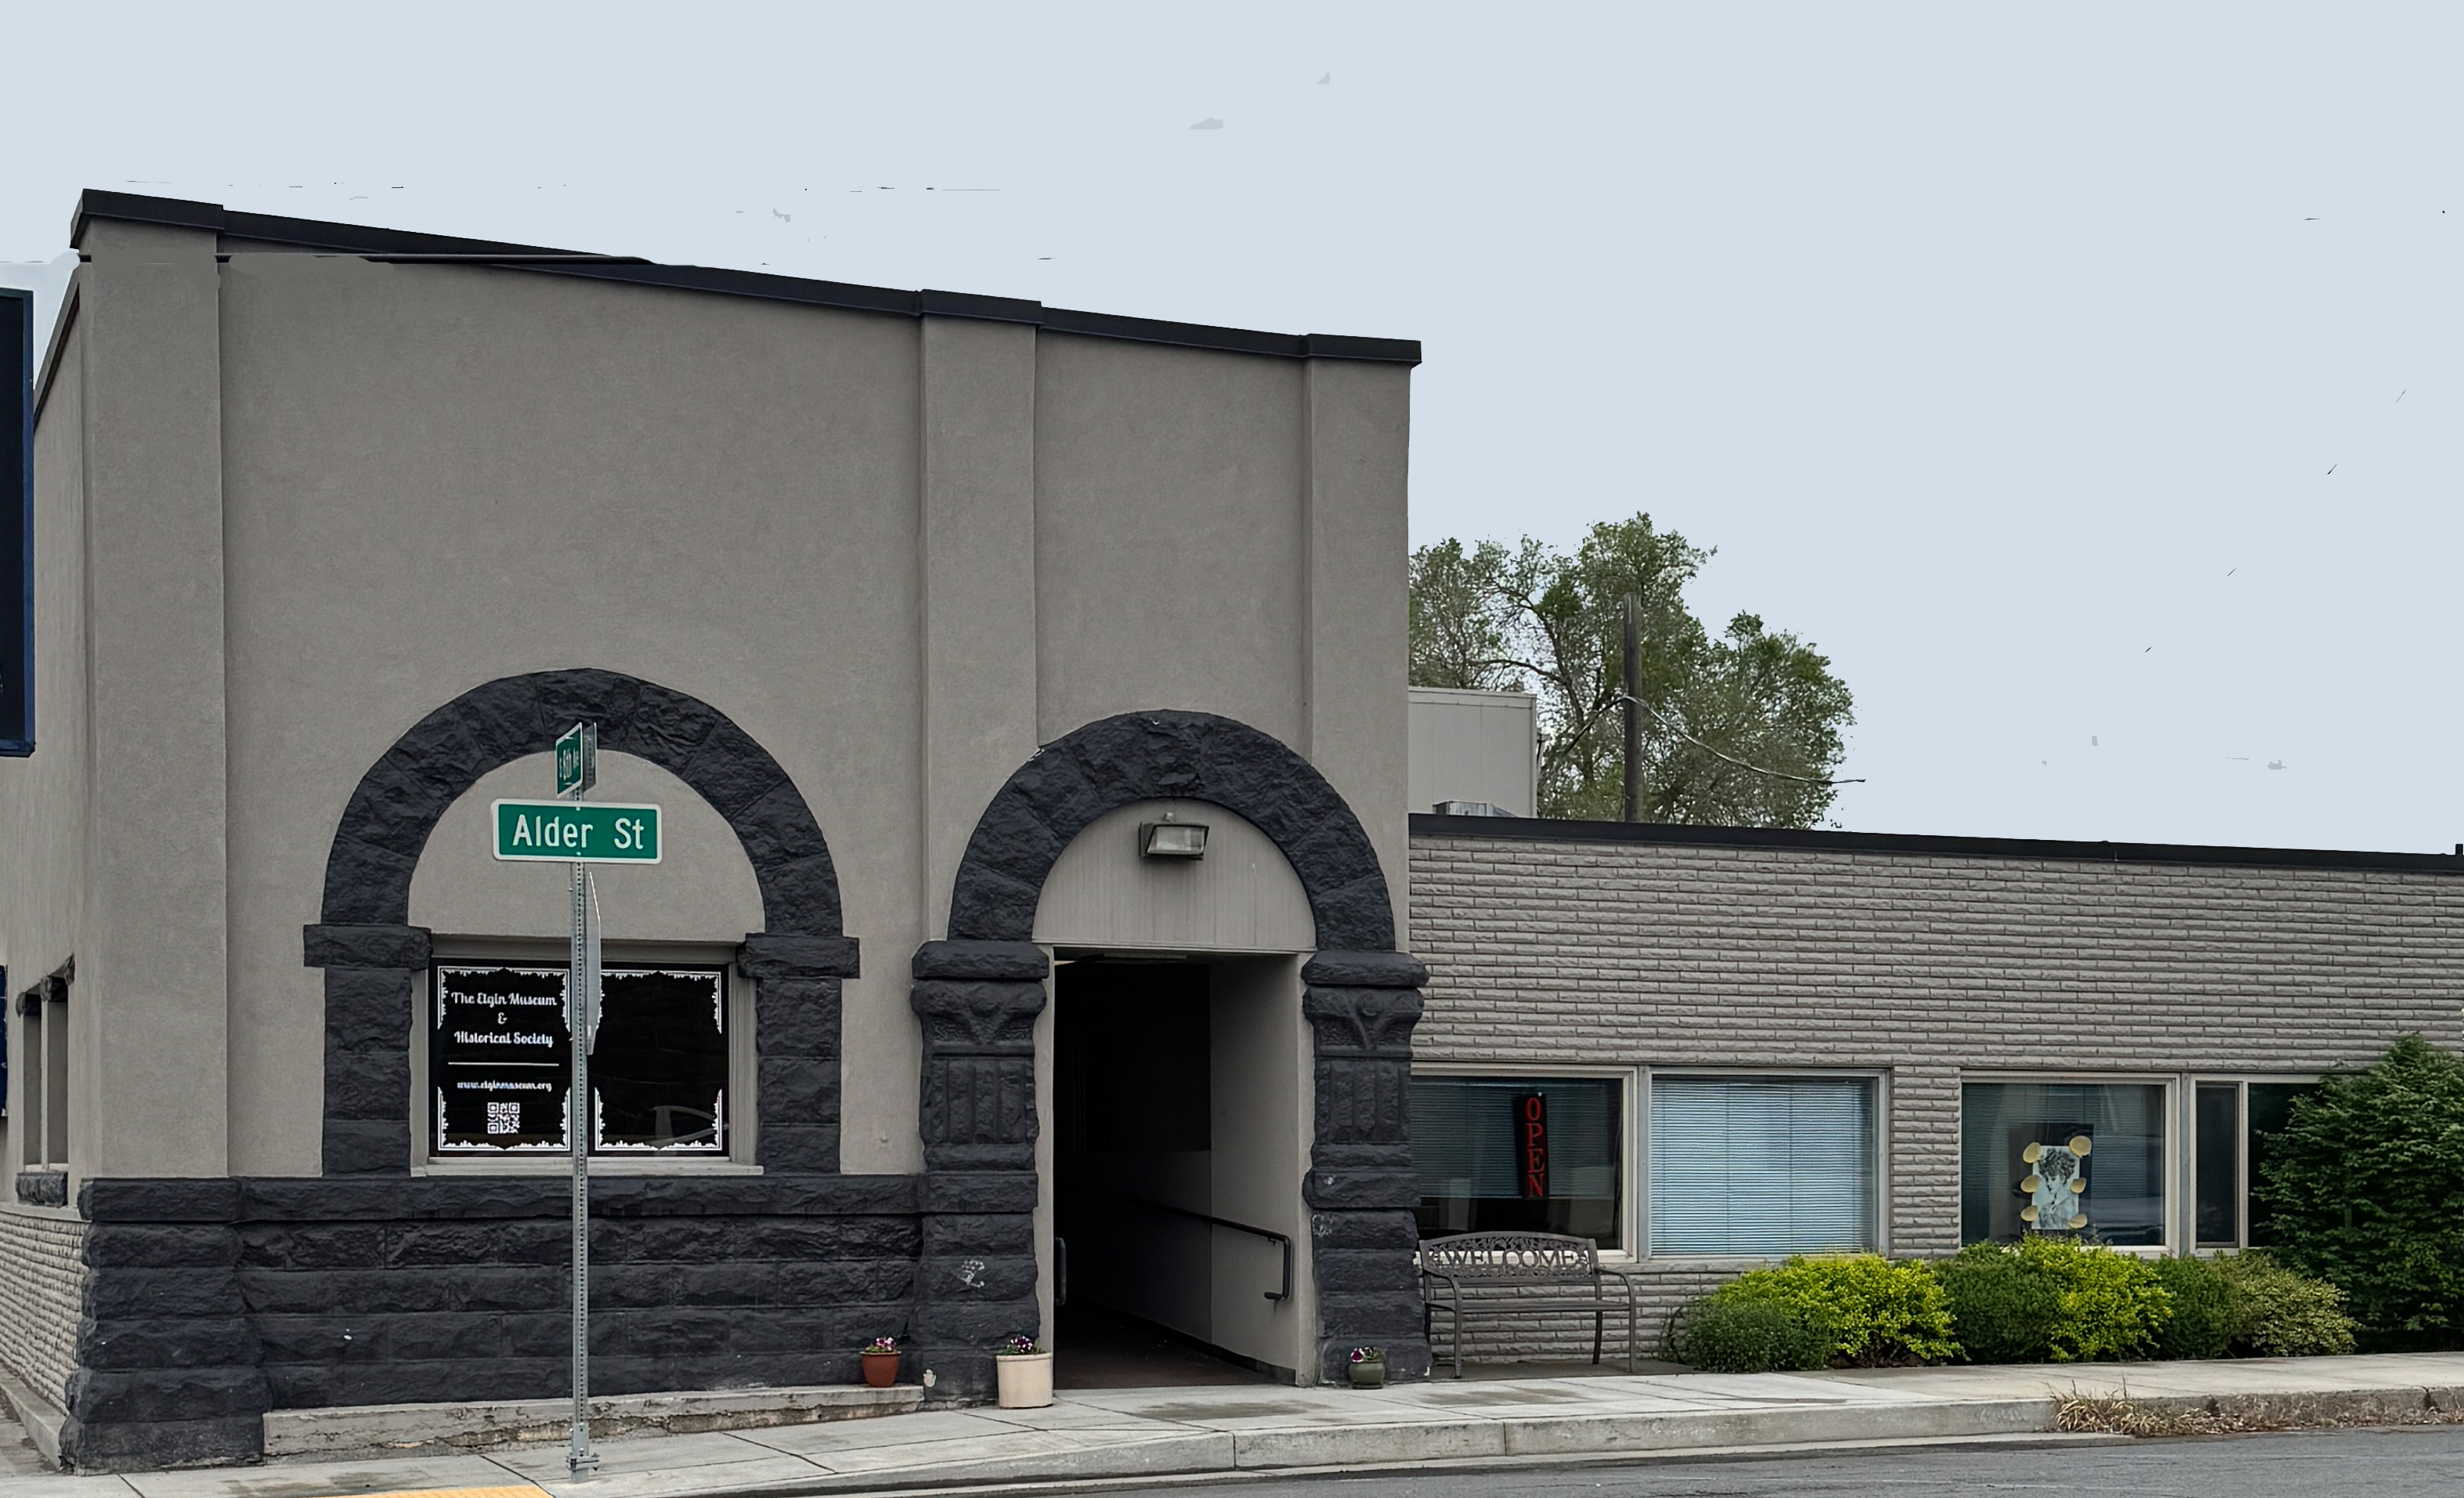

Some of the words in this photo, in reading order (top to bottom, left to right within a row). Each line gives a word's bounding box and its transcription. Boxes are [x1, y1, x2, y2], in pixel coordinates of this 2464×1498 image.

[512, 813, 593, 848] Alder
[614, 818, 645, 849] St
[451, 992, 475, 1004] The
[476, 992, 508, 1008] Elgin
[508, 993, 558, 1005] Museum
[497, 1012, 508, 1025] &
[454, 1030, 511, 1044] Historical
[513, 1032, 554, 1048] Society
[1524, 1097, 1546, 1198] OPEN
[1443, 1250, 1578, 1267] WELCOME
